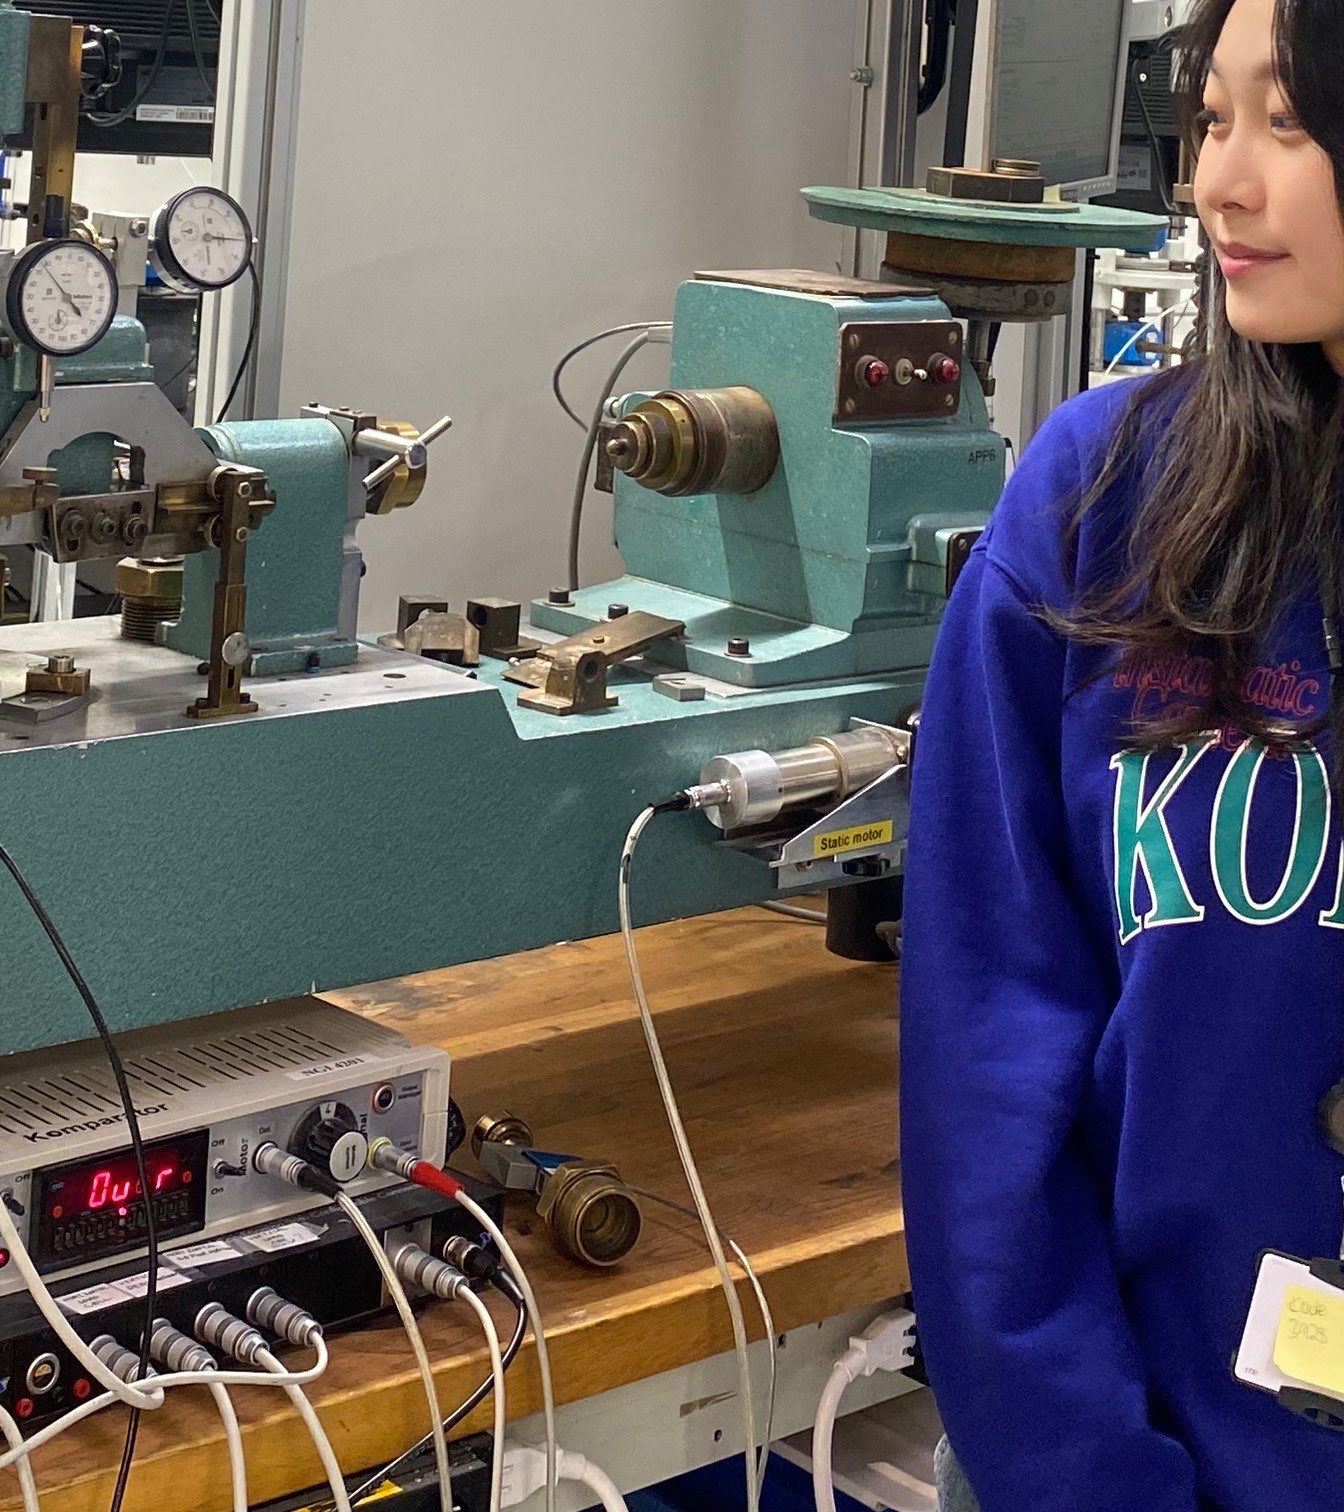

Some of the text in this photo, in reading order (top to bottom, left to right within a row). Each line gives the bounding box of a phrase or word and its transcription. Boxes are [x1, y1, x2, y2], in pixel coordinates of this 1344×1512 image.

[820, 828, 884, 851] Static motor
[22, 1103, 168, 1143] Kompartor
